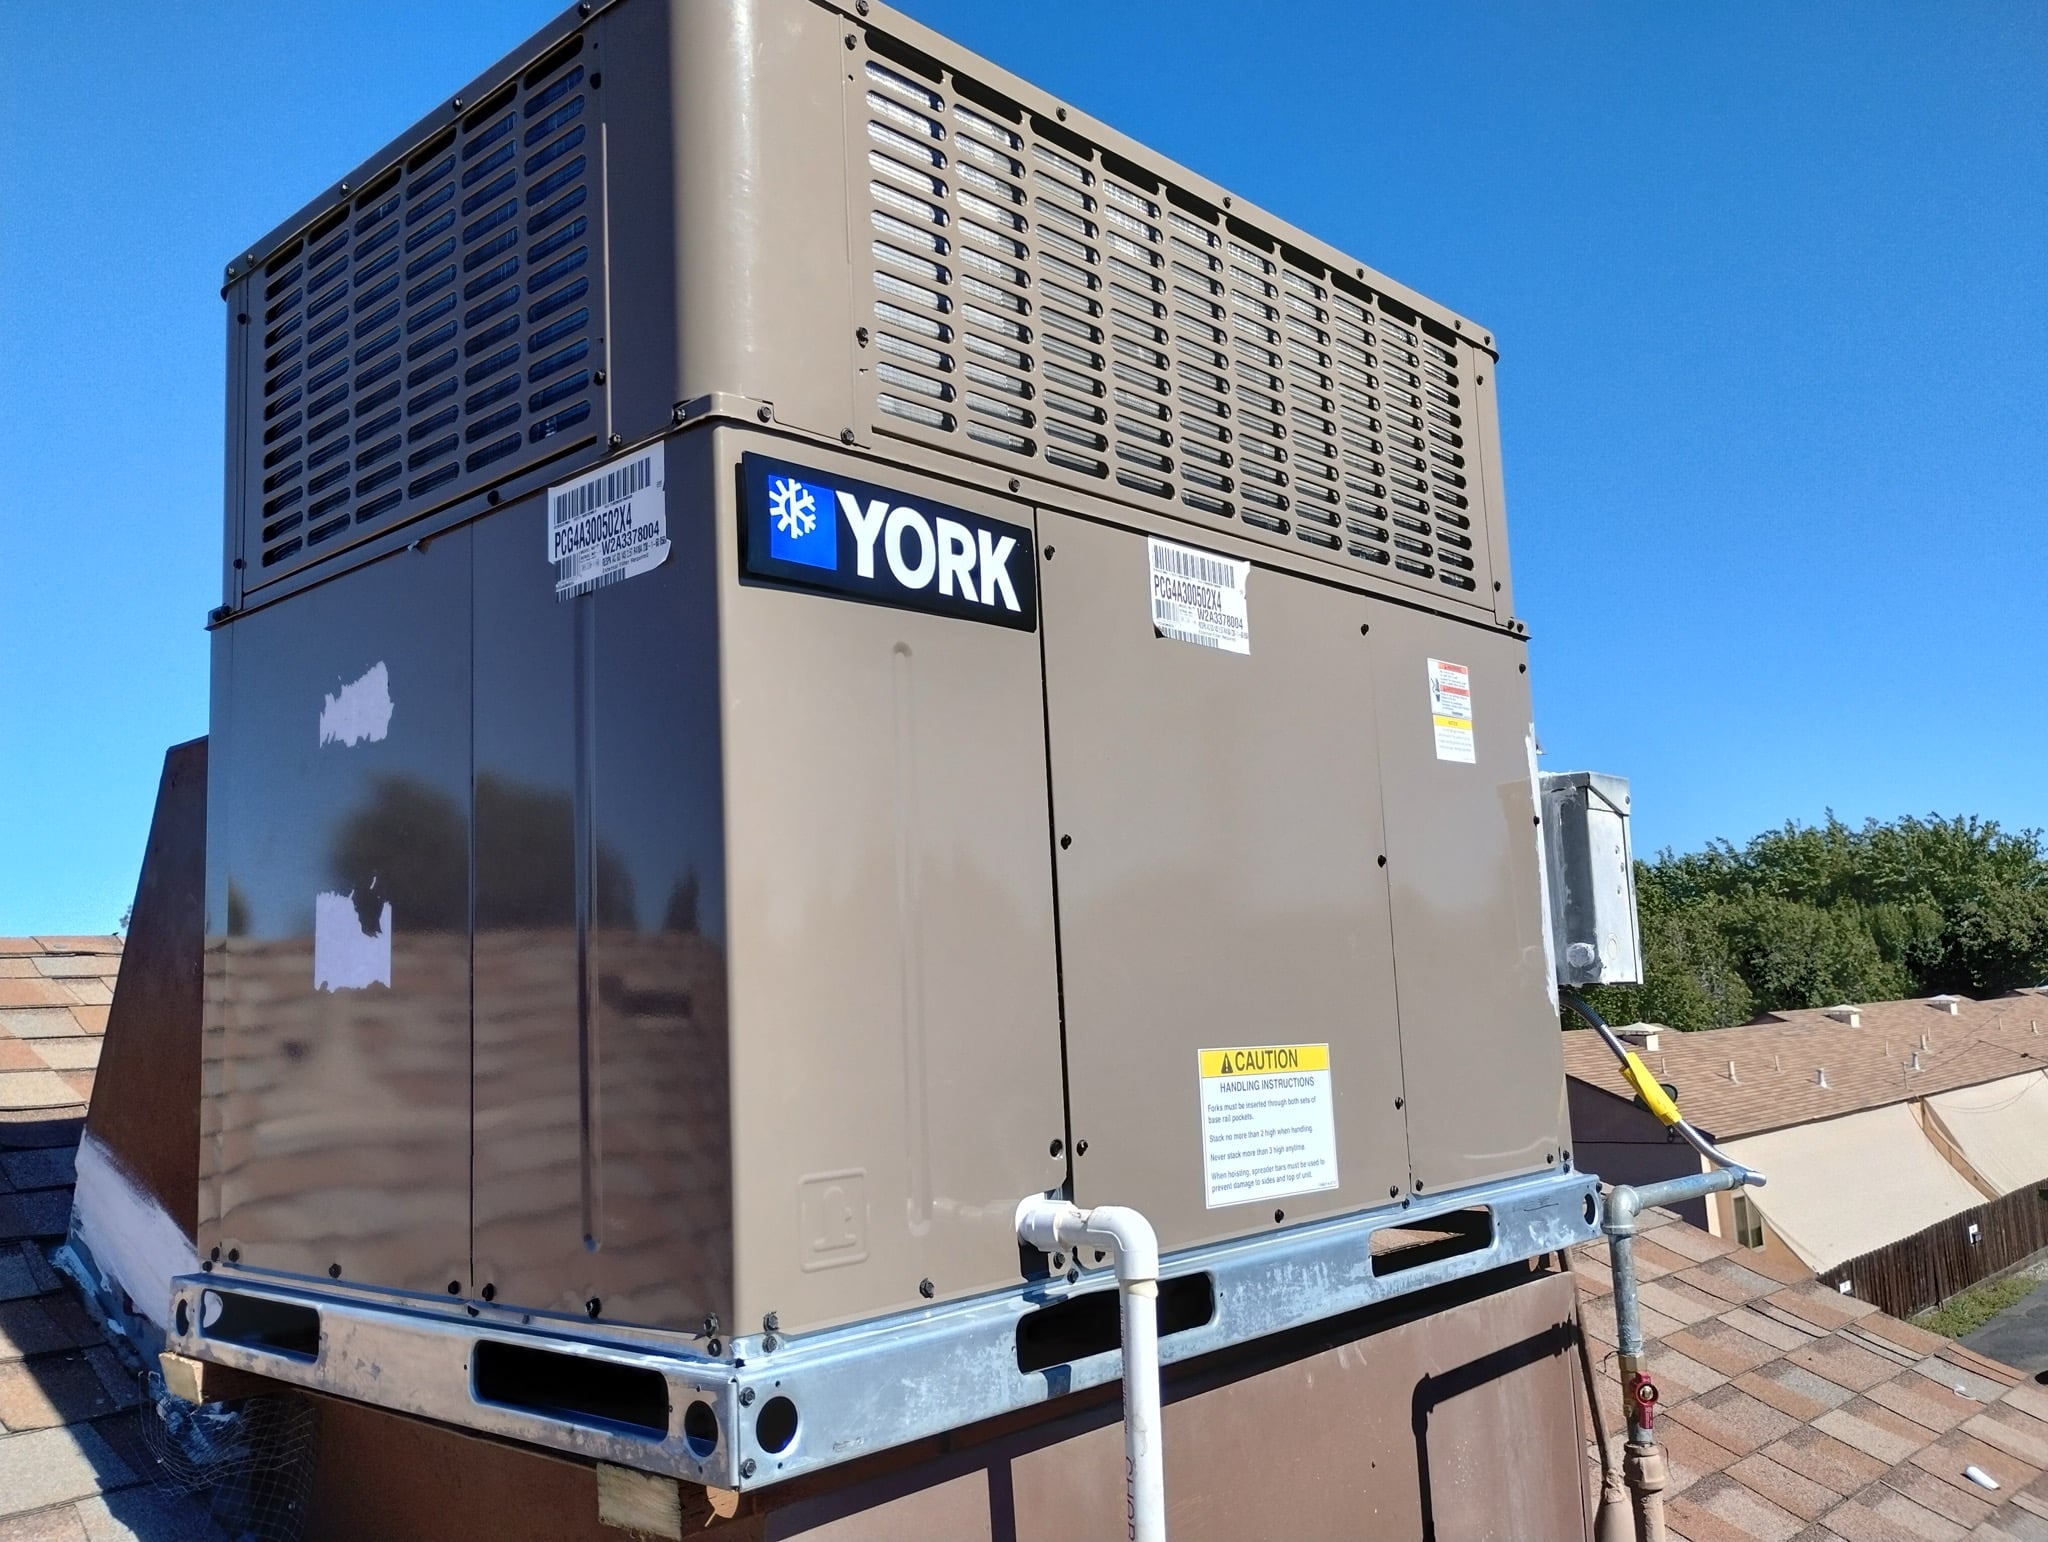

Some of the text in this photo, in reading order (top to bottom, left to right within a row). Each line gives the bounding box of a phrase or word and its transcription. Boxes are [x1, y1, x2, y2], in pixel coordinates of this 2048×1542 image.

[555, 503, 632, 558] PCG4A300502X4
[602, 520, 660, 556] W2A3378004
[835, 490, 1022, 612] YORK
[1154, 575, 1222, 612] PCG4A300502X4
[1197, 607, 1243, 630] W2A3378004
[1235, 1049, 1298, 1071] CAUTION
[1220, 1076, 1315, 1093] HANDLING INSTRUCTIONS
[1208, 1104, 1223, 1112] Forks
[1224, 1103, 1237, 1111] must
[1238, 1102, 1245, 1110] be
[1246, 1100, 1266, 1109] inserted
[1268, 1099, 1287, 1108] through
[1208, 1113, 1254, 1124] base rail pockets.
[1210, 1134, 1224, 1143] Stack
[1234, 1132, 1247, 1140] more
[1248, 1130, 1259, 1138] than
[1261, 1129, 1264, 1137] 2
[1265, 1128, 1276, 1138] high
[1277, 1127, 1290, 1135] when
[1210, 1153, 1226, 1161] Never
[1227, 1150, 1241, 1160] stack
[1256, 1148, 1268, 1156] than
[1274, 1145, 1284, 1155] high
[1211, 1171, 1227, 1180] When
[1228, 1168, 1251, 1179] hoisting,
[1252, 1164, 1274, 1175] spreader
[1275, 1163, 1286, 1172] bars
[1287, 1161, 1300, 1170] must
[1300, 1160, 1307, 1168] be
[1307, 1159, 1319, 1167] used
[1212, 1184, 1232, 1194] prevent
[1233, 1180, 1254, 1189] damage
[1255, 1178, 1260, 1186] to
[1261, 1176, 1275, 1185] sides
[1276, 1174, 1286, 1182] and
[1286, 1173, 1295, 1182] top
